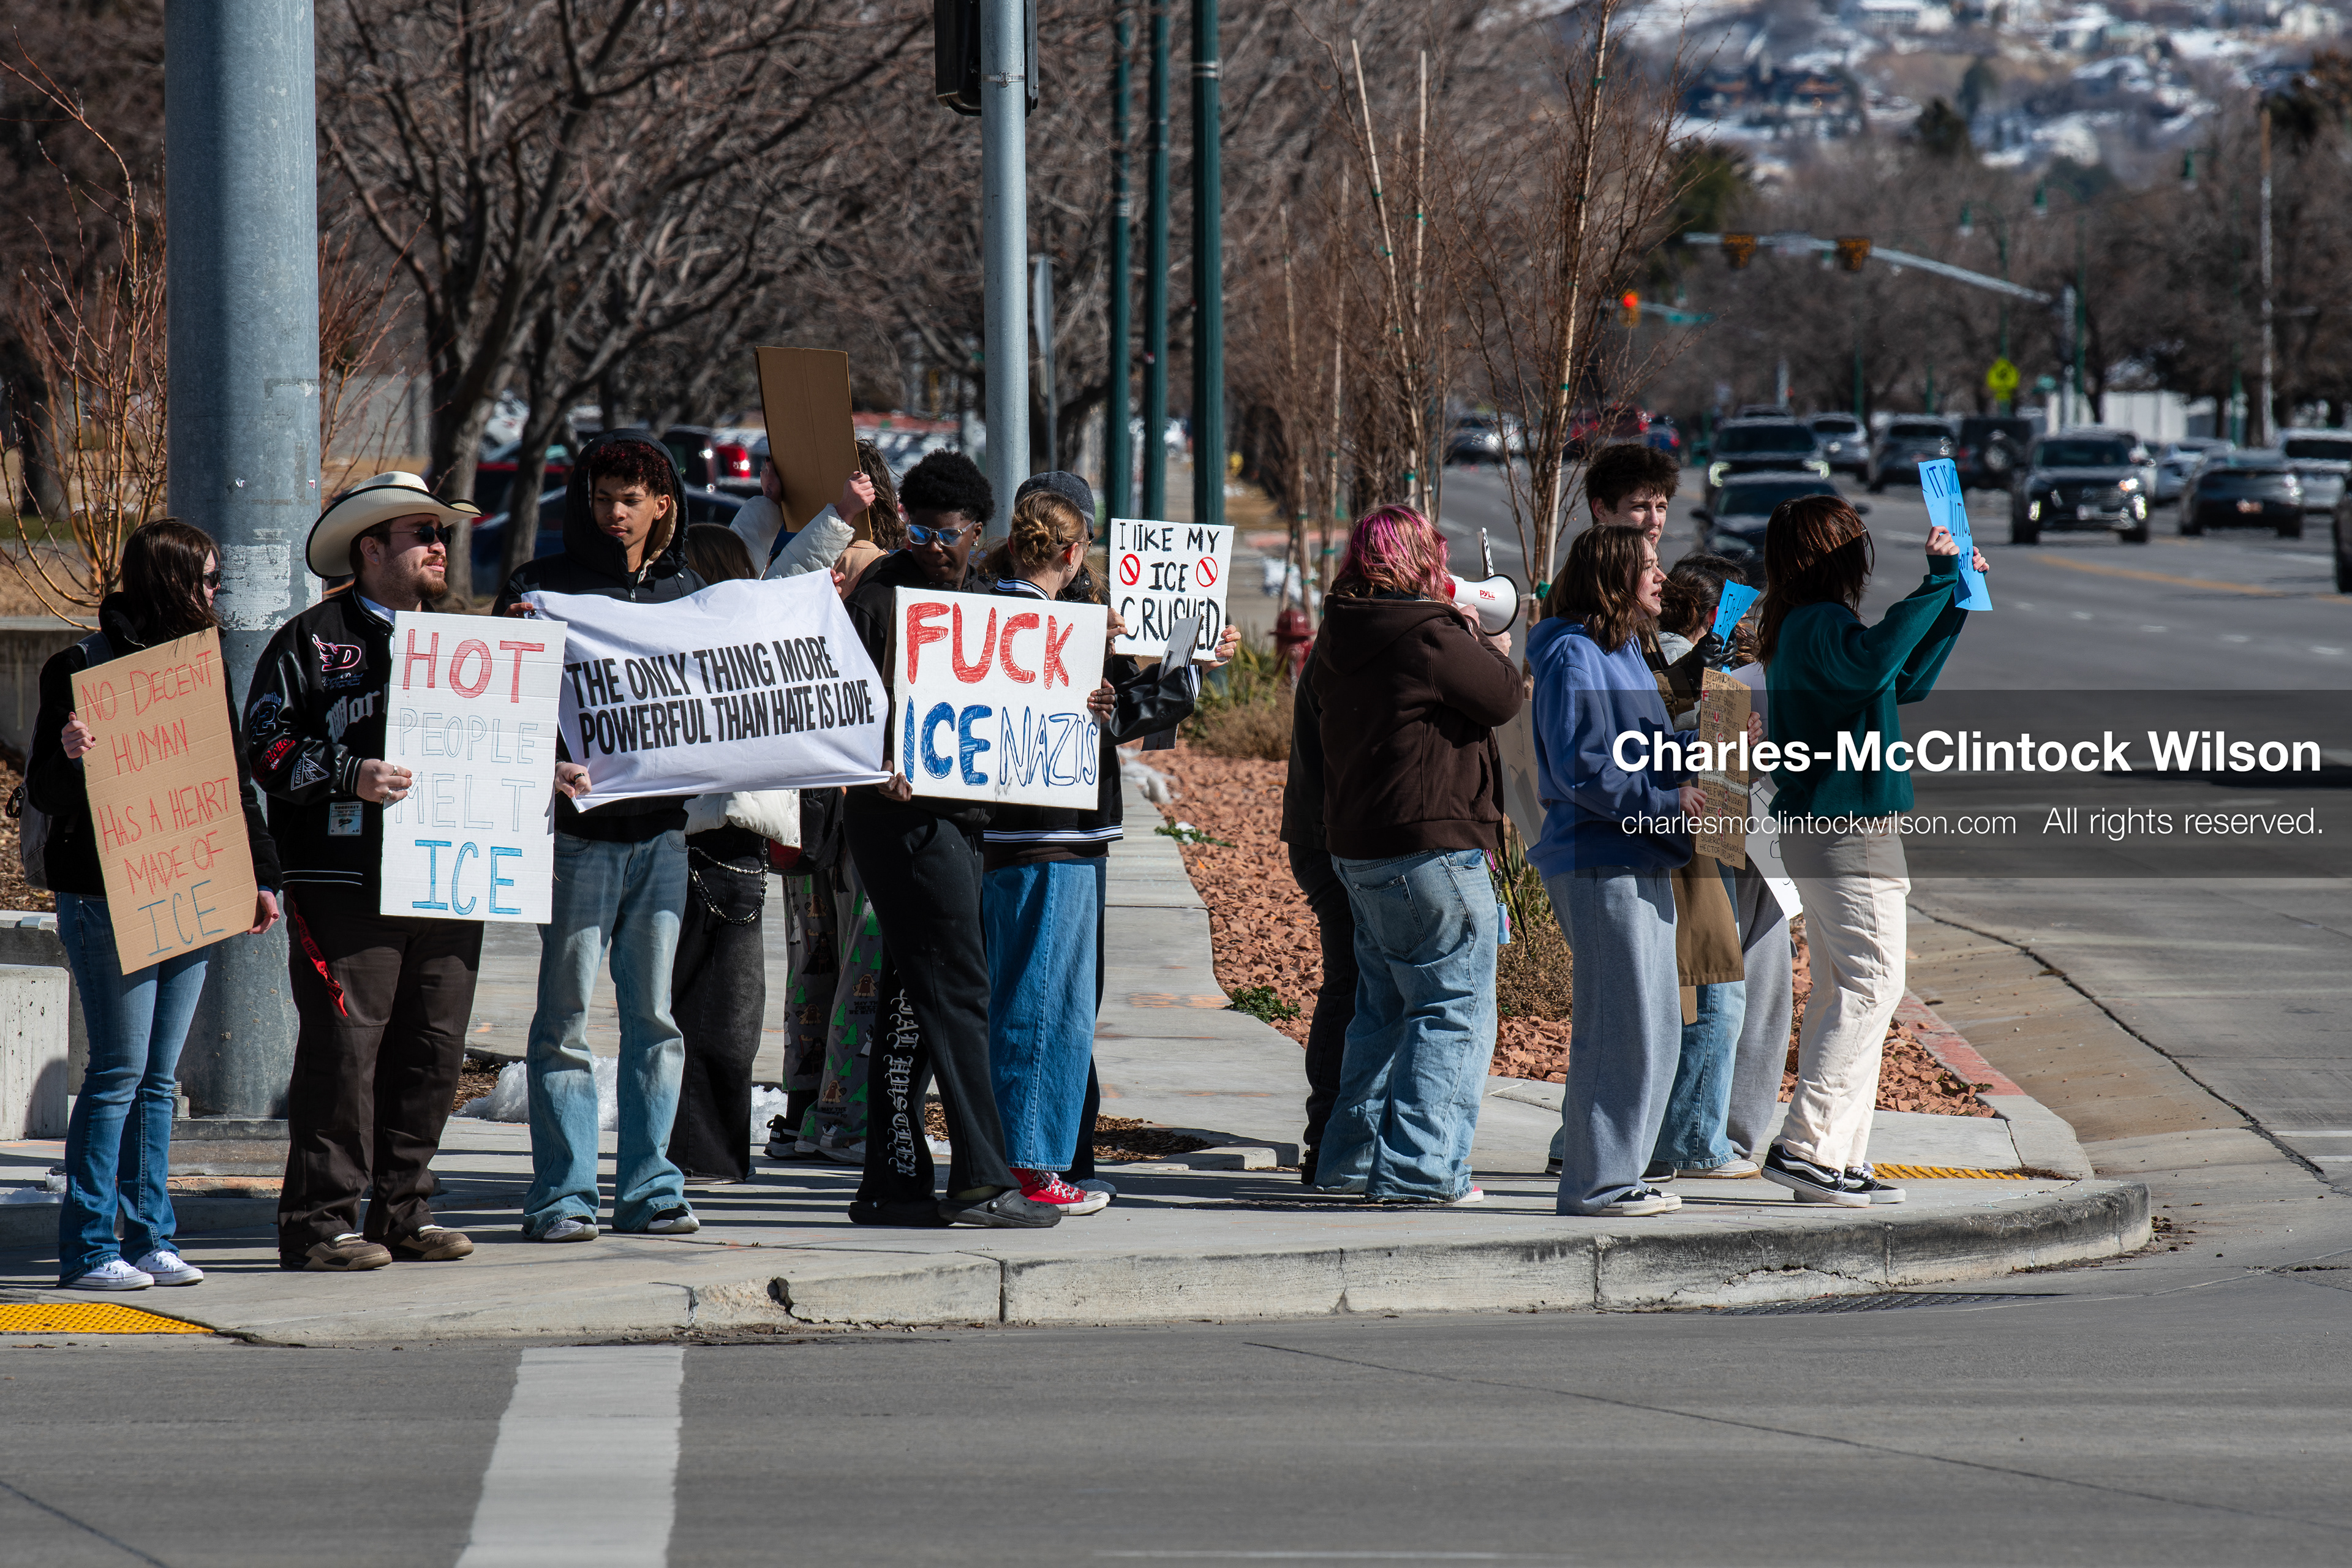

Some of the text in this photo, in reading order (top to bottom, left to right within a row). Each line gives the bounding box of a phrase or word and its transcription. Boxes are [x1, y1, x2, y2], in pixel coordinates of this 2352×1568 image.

[1926, 466, 1944, 499] IT
[1119, 522, 1126, 550] I
[1187, 526, 1220, 554] MY
[1148, 561, 1189, 593] ICE
[403, 628, 546, 704] HOT
[565, 635, 840, 709] THE ONLY THING MORE
[907, 602, 1074, 690] FUCK
[82, 650, 212, 722] NO DECENT
[1702, 690, 1721, 703] FELIX
[1703, 710, 1725, 723] MANUEL
[115, 717, 189, 775] HUMAN
[399, 708, 538, 765] PEOPLE
[579, 679, 875, 760] POWERFUL THAN HATE IS LOVE
[903, 696, 993, 786] ICE
[1702, 730, 1716, 742] JOSE
[1703, 720, 1721, 731] RENEE
[395, 771, 536, 832] MELT
[1703, 777, 1718, 786] ELENA
[98, 777, 232, 855] HAS A HEART
[124, 831, 224, 896] MADE OF
[412, 839, 523, 916] ICE
[138, 879, 225, 958] ICE
